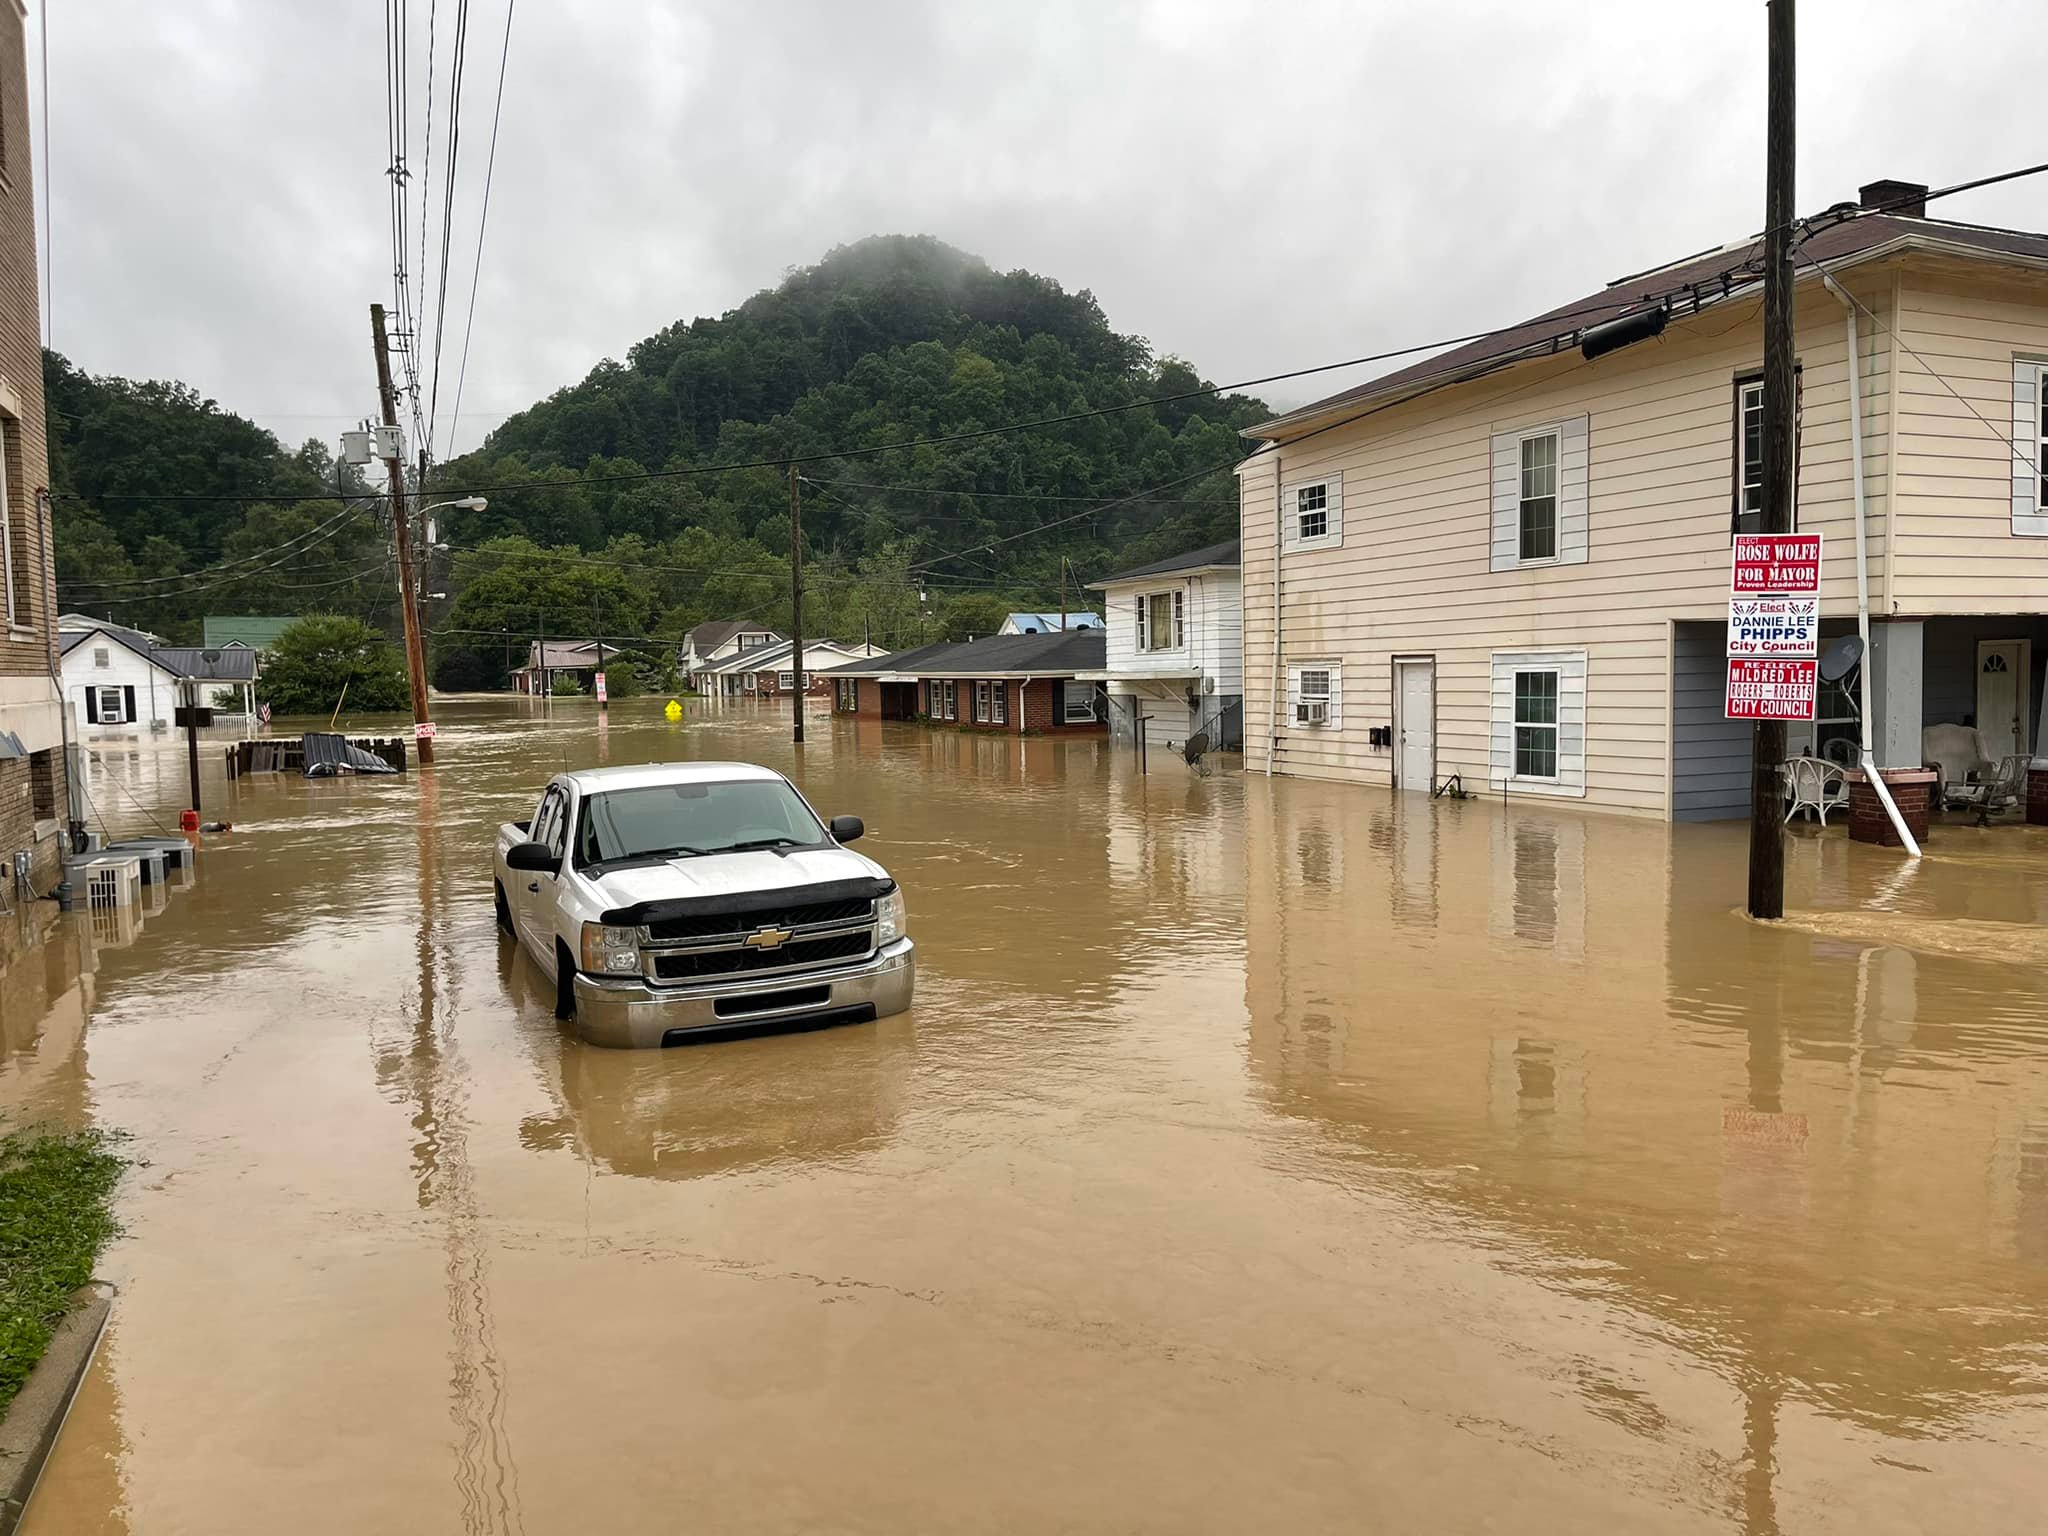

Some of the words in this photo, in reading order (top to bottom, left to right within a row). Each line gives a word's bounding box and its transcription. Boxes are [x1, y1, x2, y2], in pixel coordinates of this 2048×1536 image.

[1737, 544, 1770, 561] ROSE
[1775, 544, 1818, 560] WOLFE
[1737, 568, 1763, 581] FOR
[1768, 567, 1815, 581] MAYOR
[1760, 603, 1786, 612] Elect
[1732, 616, 1784, 626] DANNIE
[1788, 616, 1815, 626] LEE
[1740, 628, 1808, 640] PHIPPS
[1730, 640, 1758, 652] City
[1761, 640, 1814, 651] Council
[1732, 668, 1784, 682] MILDRED
[1790, 670, 1813, 683] LEE
[1732, 700, 1758, 714] CITY
[1760, 700, 1810, 716] COUNCIL
